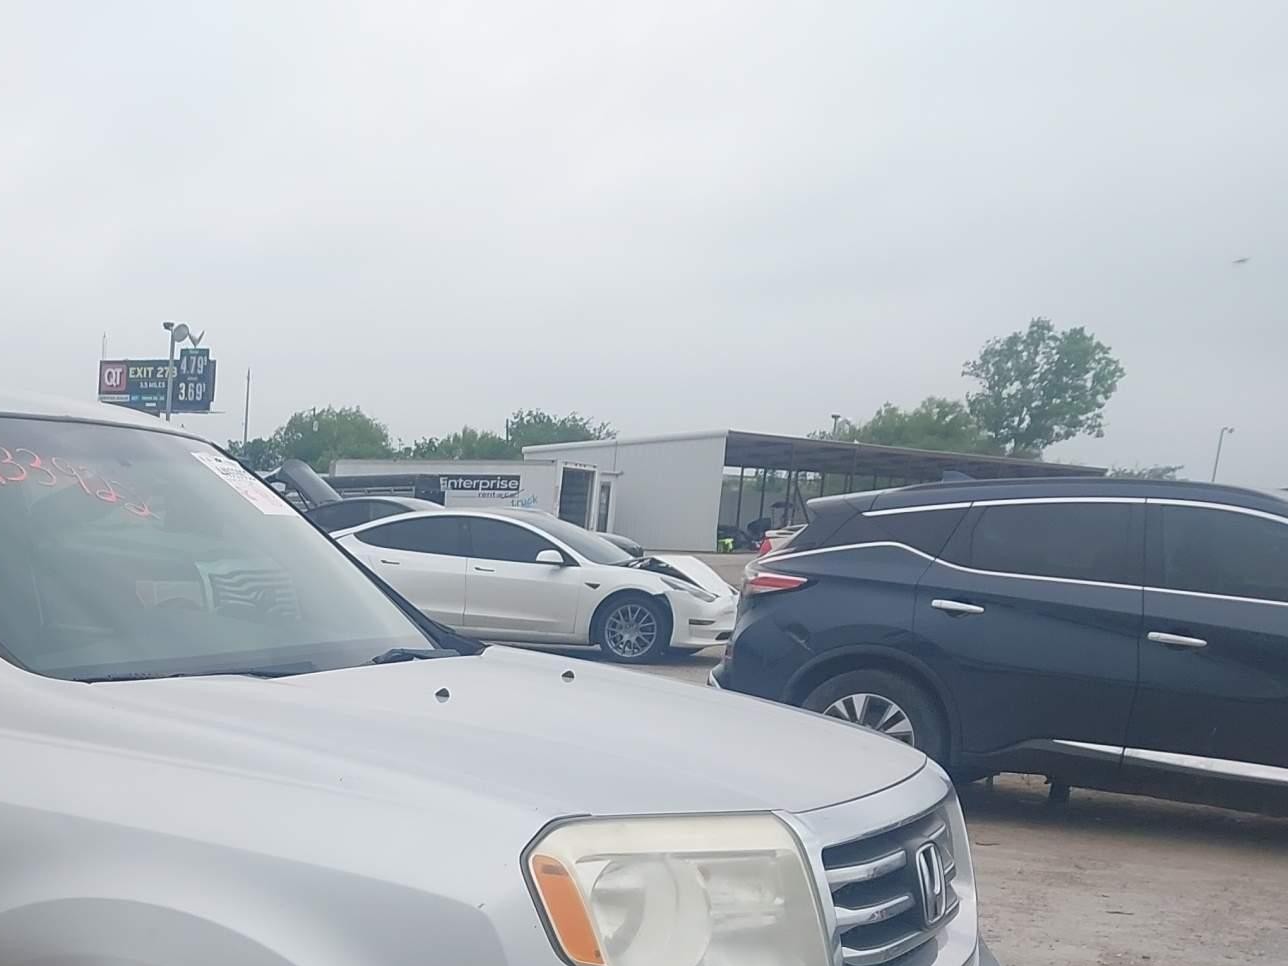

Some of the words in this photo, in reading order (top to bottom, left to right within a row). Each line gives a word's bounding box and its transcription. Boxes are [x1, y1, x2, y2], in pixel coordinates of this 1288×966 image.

[104, 368, 122, 387] QT
[129, 367, 154, 378] EXIT
[511, 497, 537, 507] truck
